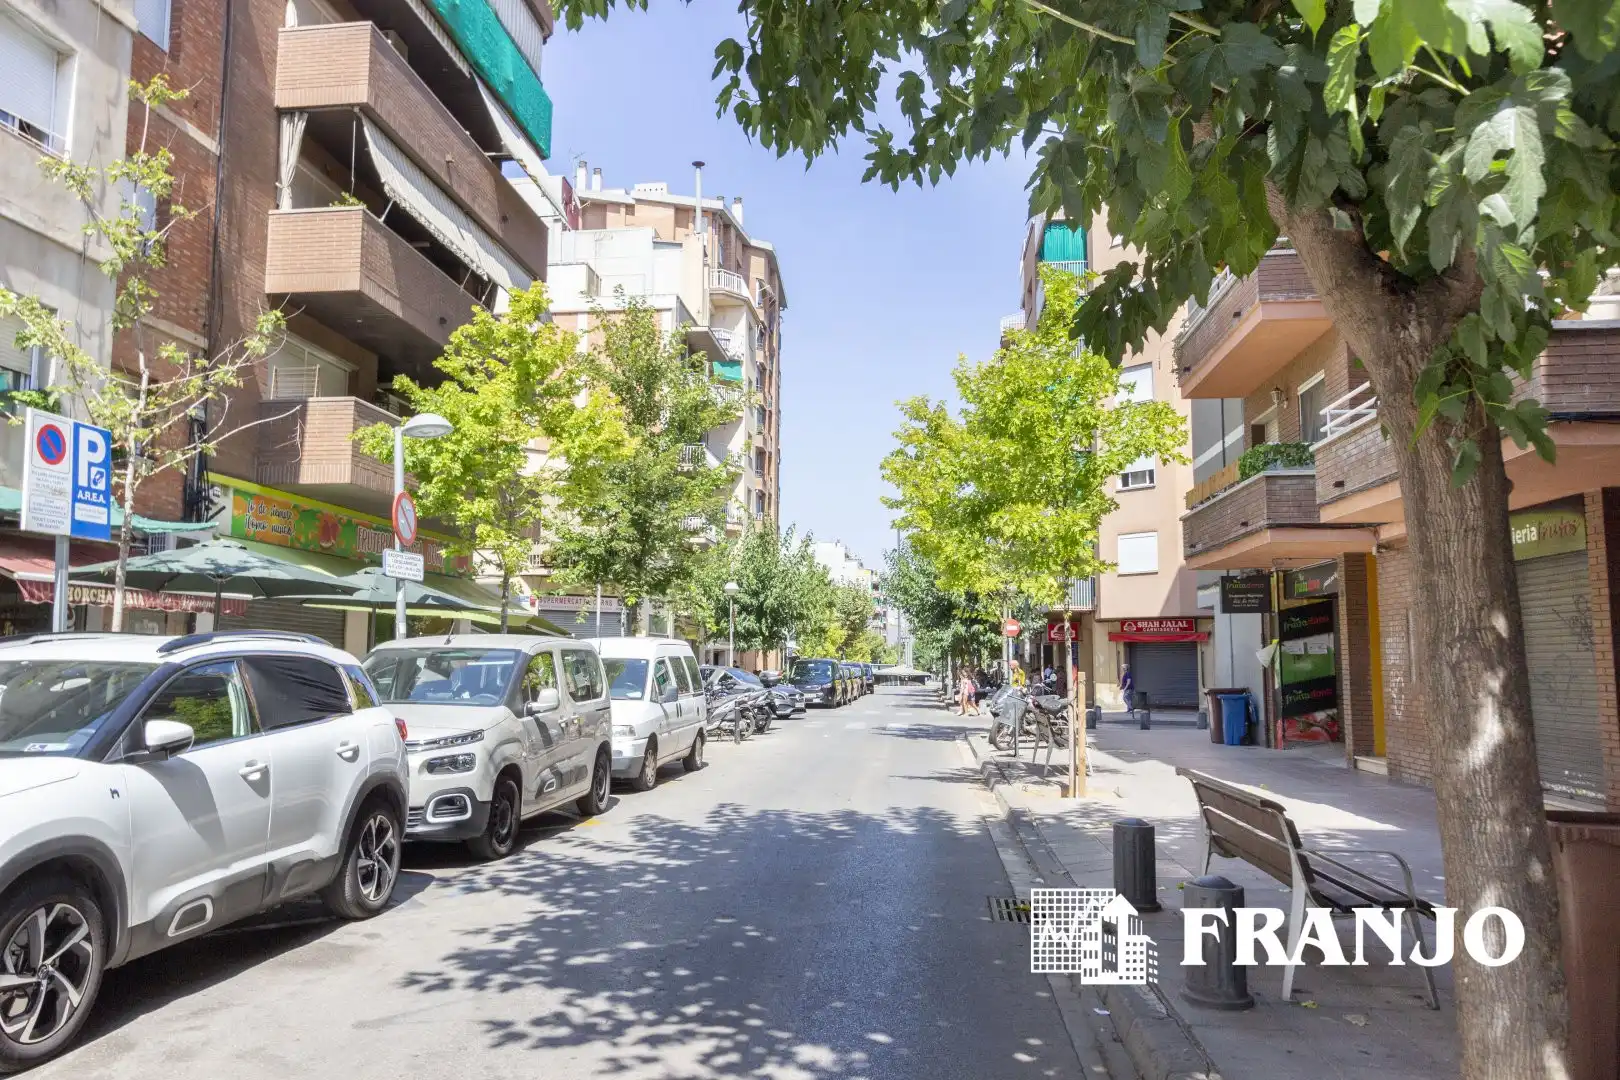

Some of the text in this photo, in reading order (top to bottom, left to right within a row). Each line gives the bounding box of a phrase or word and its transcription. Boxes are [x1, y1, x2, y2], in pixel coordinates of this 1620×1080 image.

[78, 427, 106, 487] P
[1511, 524, 1539, 545] ieria
[68, 586, 145, 608] HORCHARIA
[1137, 620, 1189, 628] SHAH JALAL
